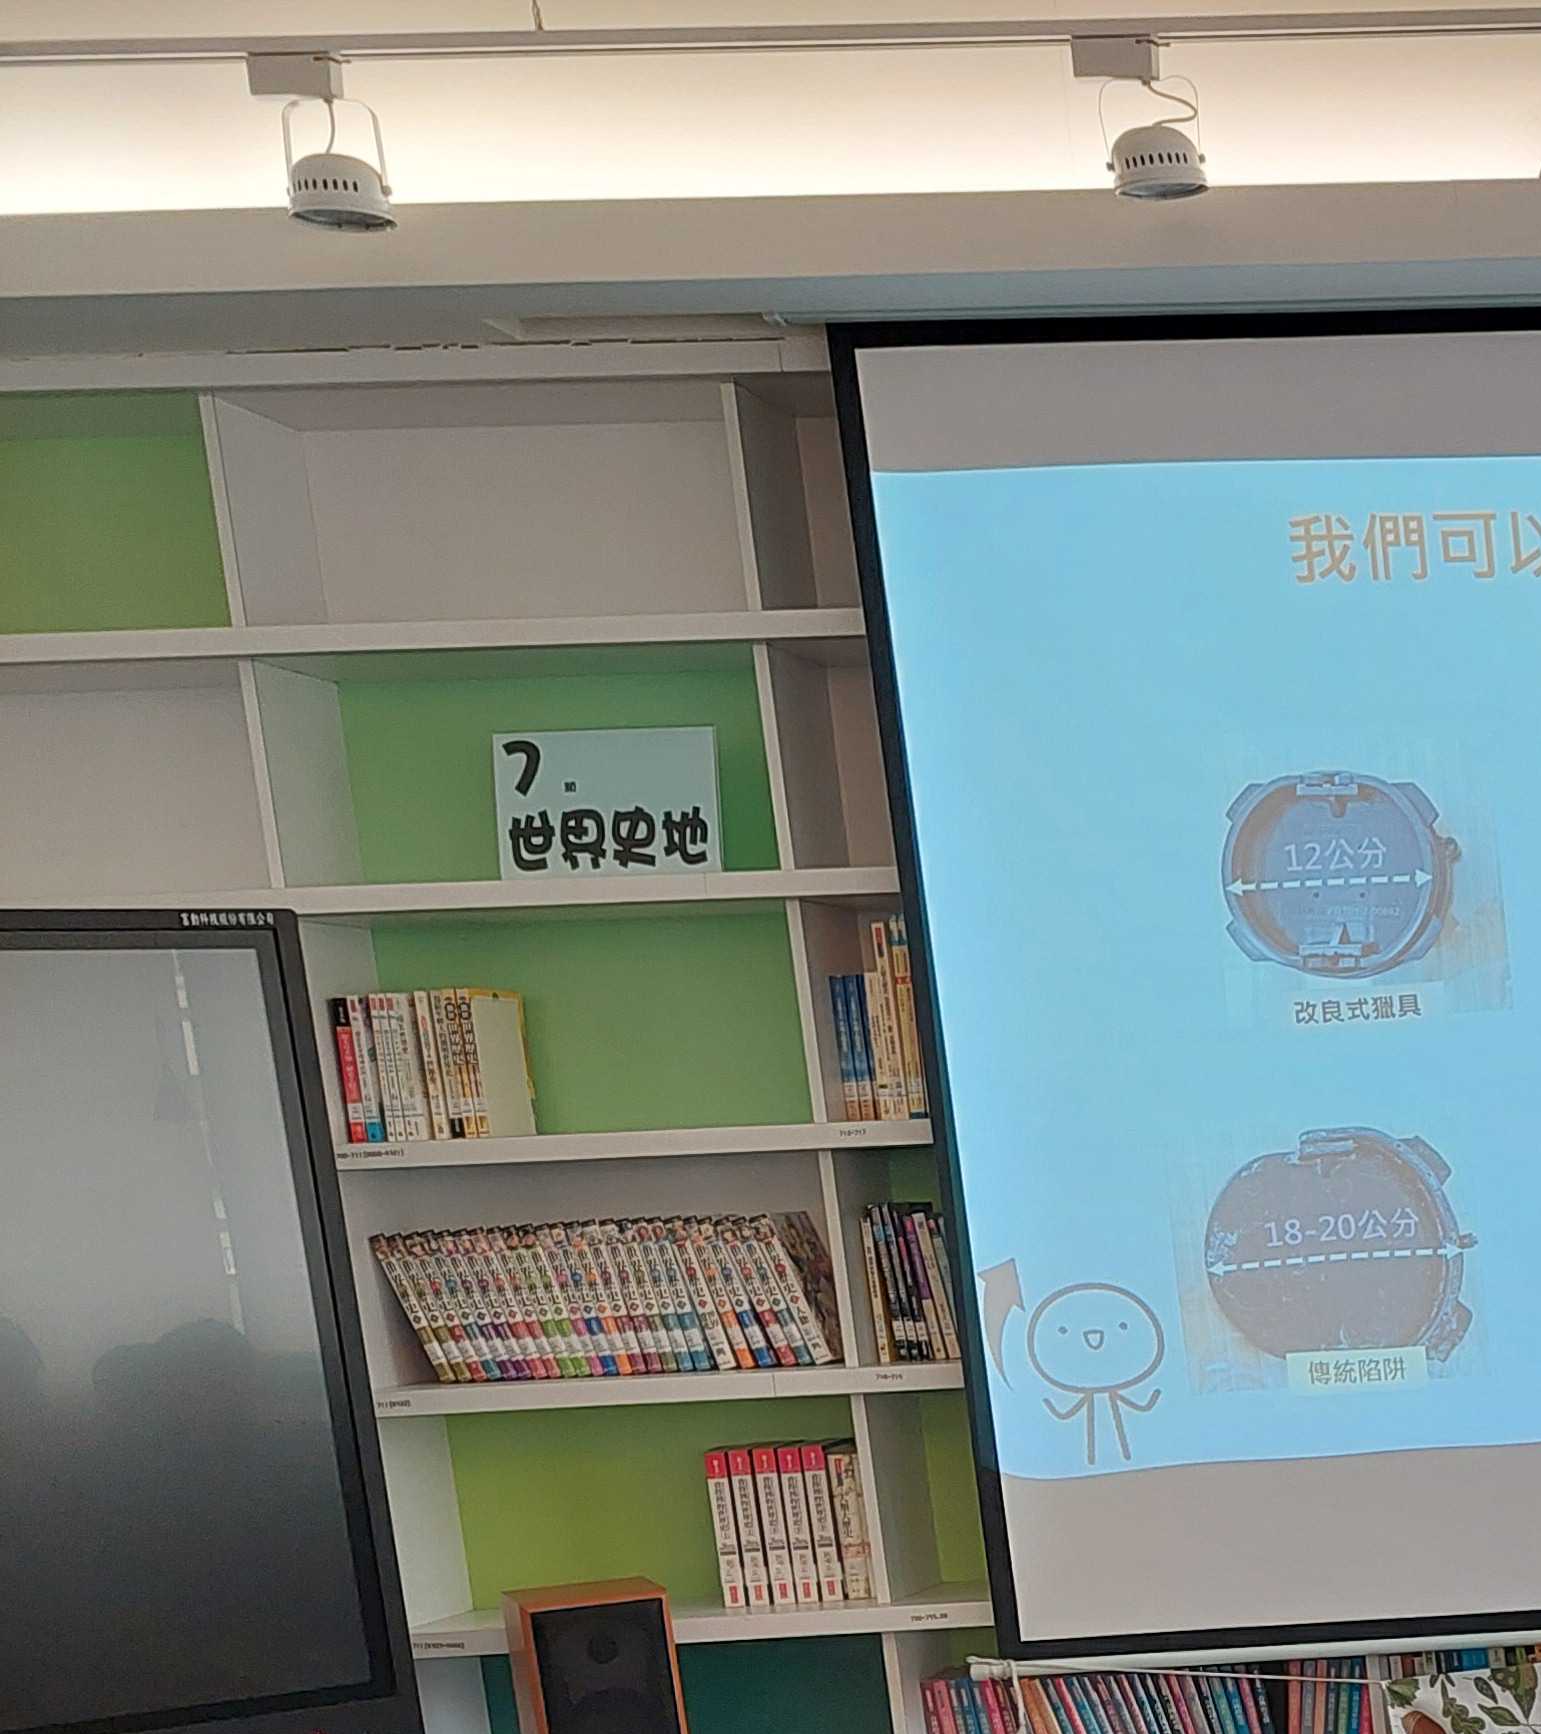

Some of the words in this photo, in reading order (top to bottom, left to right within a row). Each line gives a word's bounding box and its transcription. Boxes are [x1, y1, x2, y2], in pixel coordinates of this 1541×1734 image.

[509, 805, 709, 871] 世界史地
[1284, 839, 1387, 872] 12公分
[1294, 992, 1423, 1026] 改良式獵具
[1264, 1207, 1420, 1247] 18-20公分
[1307, 1356, 1407, 1385] 傳統陷阱
